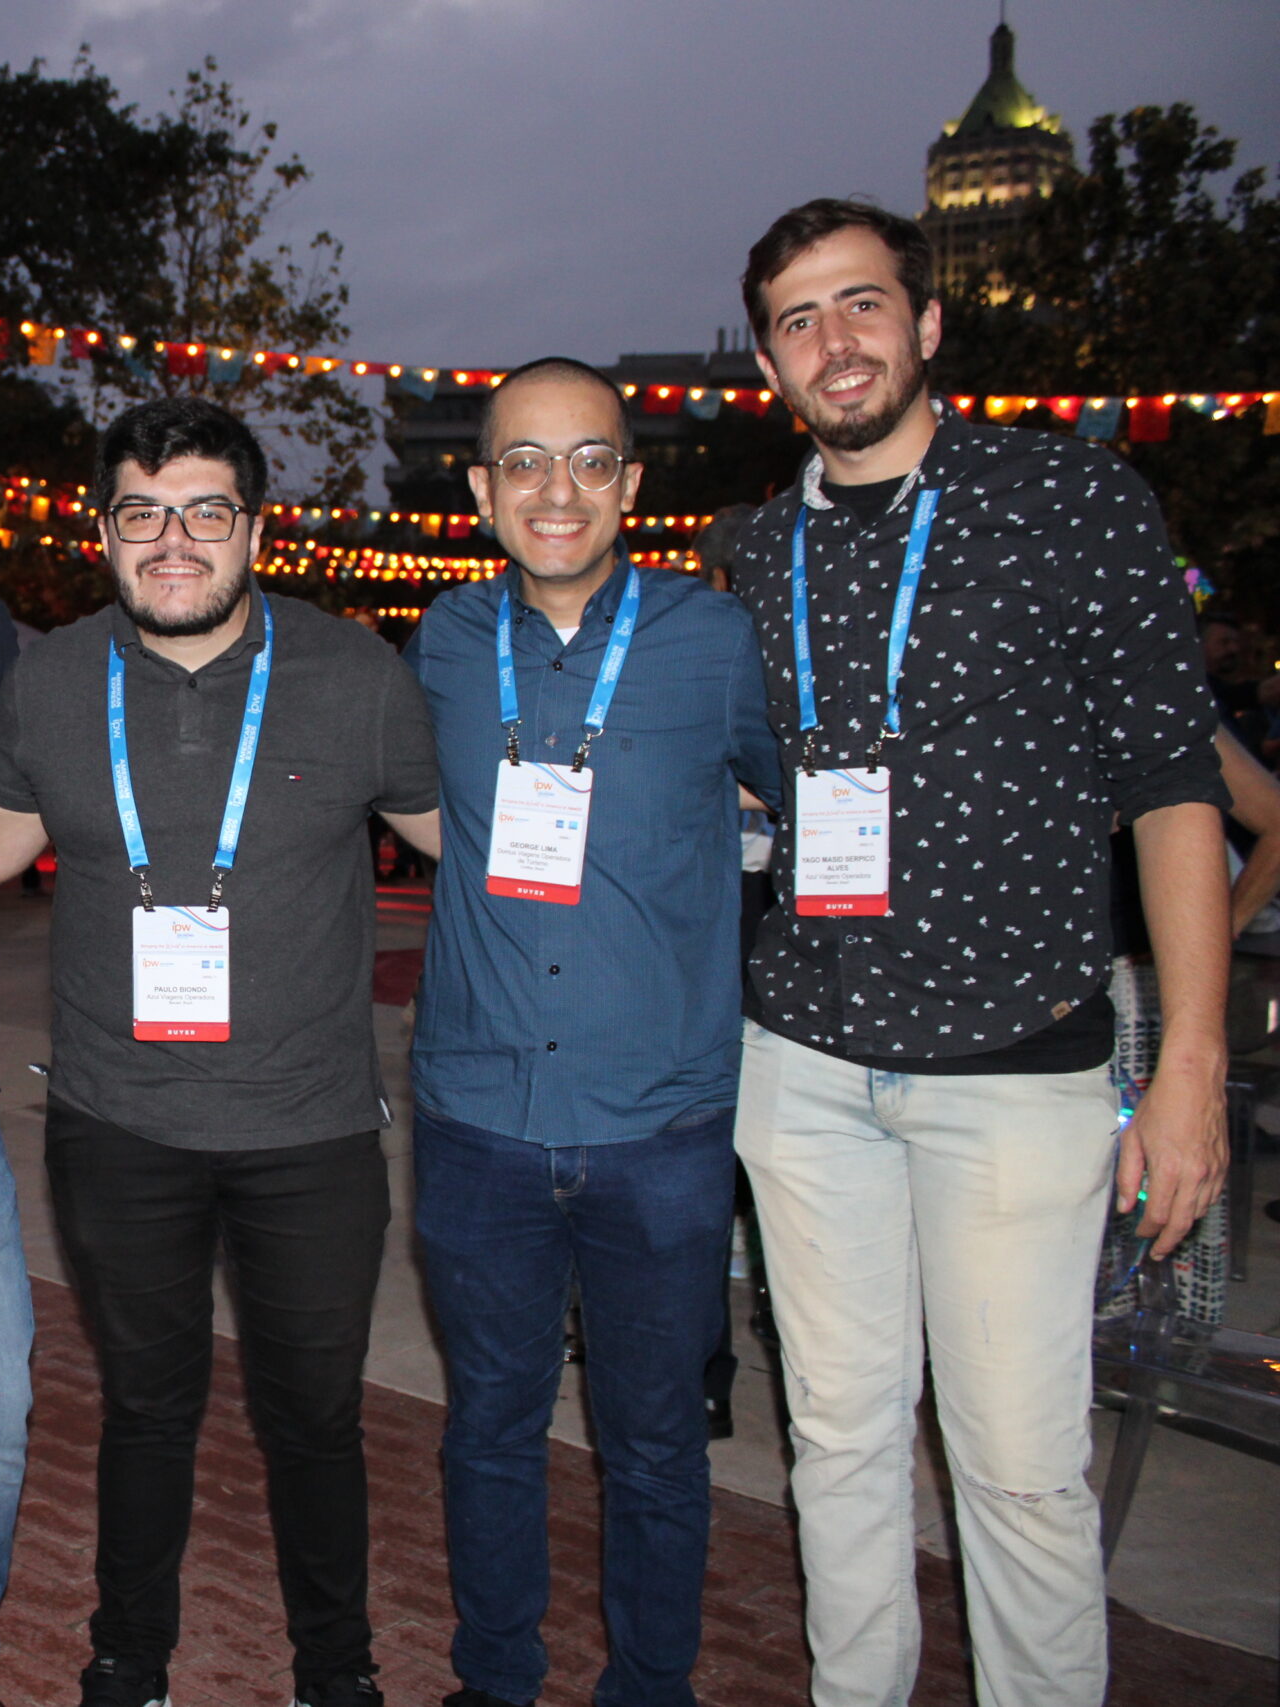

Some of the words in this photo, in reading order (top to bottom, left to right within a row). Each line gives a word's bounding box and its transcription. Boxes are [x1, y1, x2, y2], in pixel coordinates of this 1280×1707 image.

[246, 694, 261, 714] ipw
[111, 719, 123, 738] ipw
[534, 778, 553, 792] ipw
[832, 785, 851, 798] ipw
[510, 841, 539, 851] GEORGE
[540, 845, 558, 853] LIMA
[517, 888, 545, 896] BUYER
[172, 921, 191, 934] ipw
[143, 958, 159, 968] ipw
